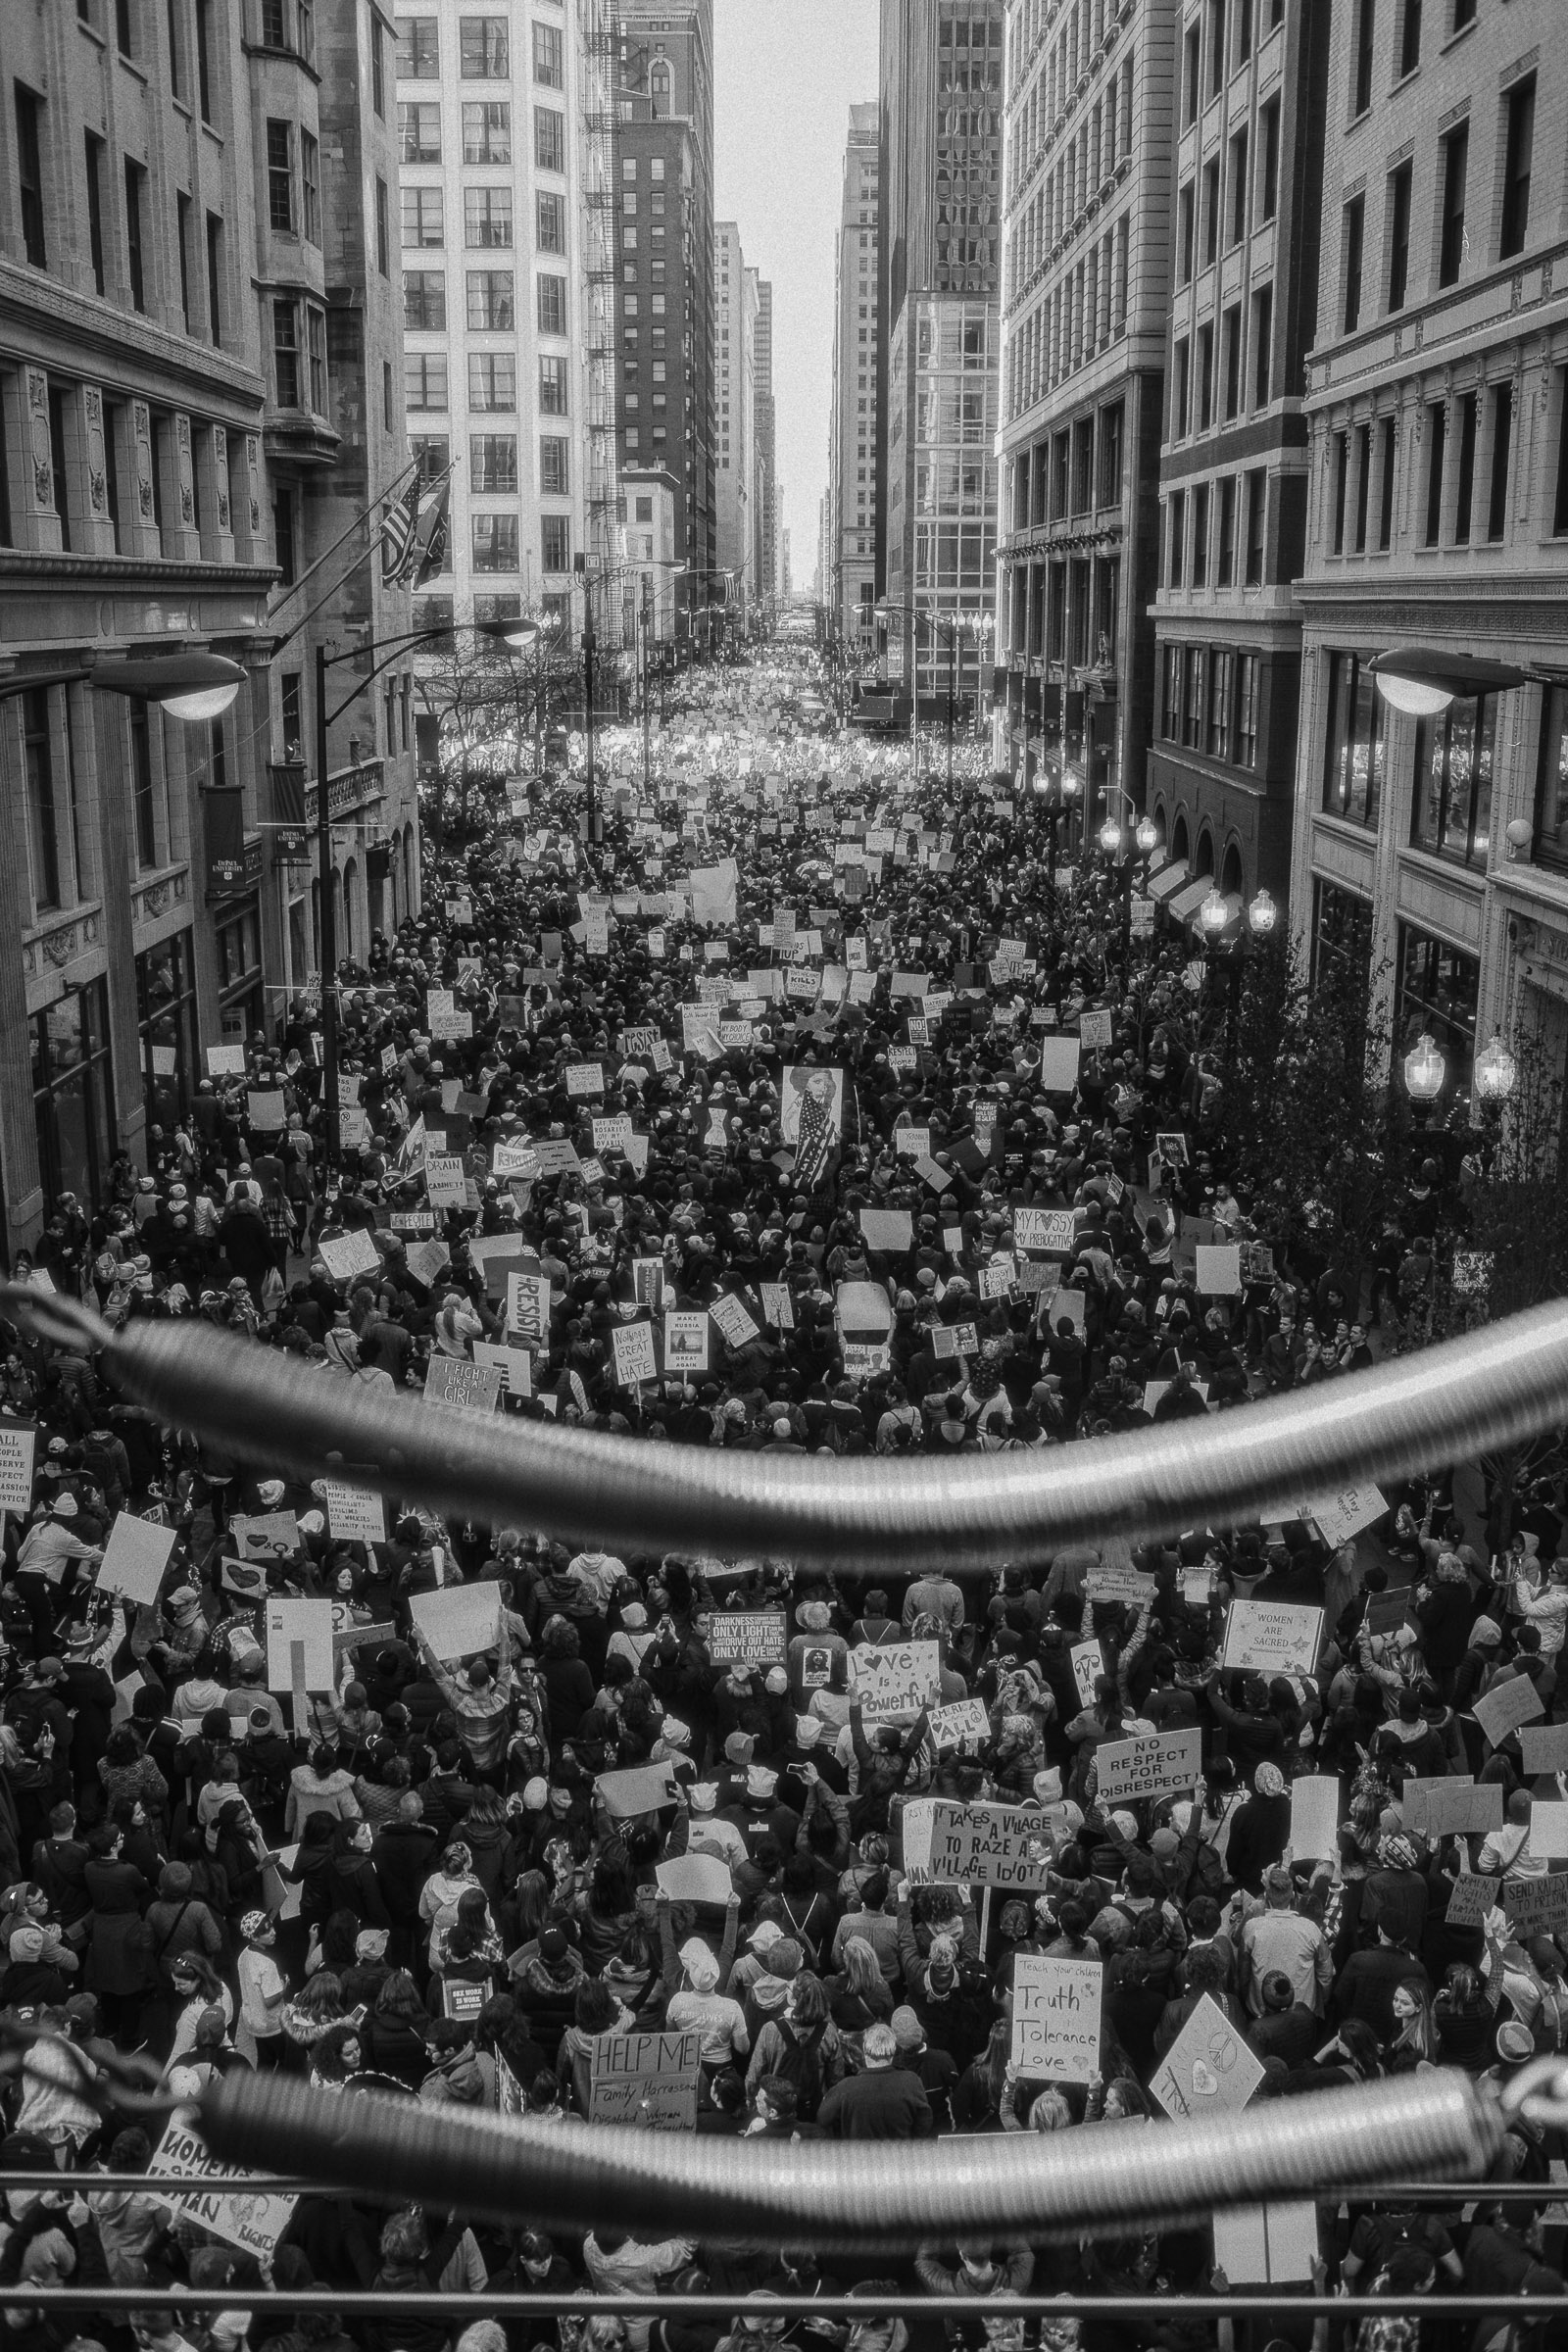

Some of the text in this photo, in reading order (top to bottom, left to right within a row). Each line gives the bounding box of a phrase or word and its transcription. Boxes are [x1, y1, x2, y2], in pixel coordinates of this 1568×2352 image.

[790, 976, 816, 985] KILLS
[909, 1019, 925, 1030] NO!
[625, 1029, 659, 1054] resist
[728, 1033, 751, 1042] CHOICE
[426, 1160, 461, 1171] DRAIN
[1015, 1211, 1032, 1230] MY
[1015, 1232, 1073, 1248] MY PREROGATIVE
[516, 1275, 541, 1338] #RESIST
[614, 1326, 647, 1345] Nothing's
[617, 1340, 649, 1358] GREAT
[444, 1362, 489, 1382] I FIGHT
[619, 1360, 652, 1382] HATE
[448, 1375, 478, 1389] LIKE A
[444, 1385, 475, 1406] GIRL
[1346, 1487, 1361, 1513] Tiny
[1256, 1613, 1294, 1625] WOMEN
[712, 1626, 738, 1638] ONLY
[740, 1626, 769, 1638] LIGHT
[1263, 1626, 1283, 1636] ARE
[725, 1638, 747, 1646] DRIVE
[763, 1638, 785, 1646] HATE;
[1253, 1636, 1290, 1648] SACRED
[713, 1646, 739, 1658] ONLY
[741, 1646, 766, 1658] LOVE
[931, 1700, 978, 1724] AMERICA
[940, 1719, 976, 1741] ALL
[1134, 1738, 1161, 1753] NO
[1109, 1747, 1189, 1772] RESPECT
[1129, 1763, 1163, 1780] FOR
[948, 1808, 991, 1829] TAKES
[989, 1823, 999, 1840] A
[1003, 1815, 1052, 1835] VILLAGE
[945, 1836, 1028, 1858] TO RAZE A
[933, 1855, 988, 1880] VILLAGE
[1508, 1882, 1535, 1901] SEND
[1450, 1903, 1483, 1916] HUMAN
[1516, 1899, 1530, 1912] TO
[1019, 1960, 1101, 1978] Teach your children
[1017, 1984, 1080, 2011] Truth
[1015, 2019, 1097, 2046] Tolerance
[596, 2034, 702, 2076] HELP ME!
[1019, 2047, 1067, 2071] Love
[593, 2082, 637, 2108] Family
[237, 2224, 276, 2252] RIGHTS
